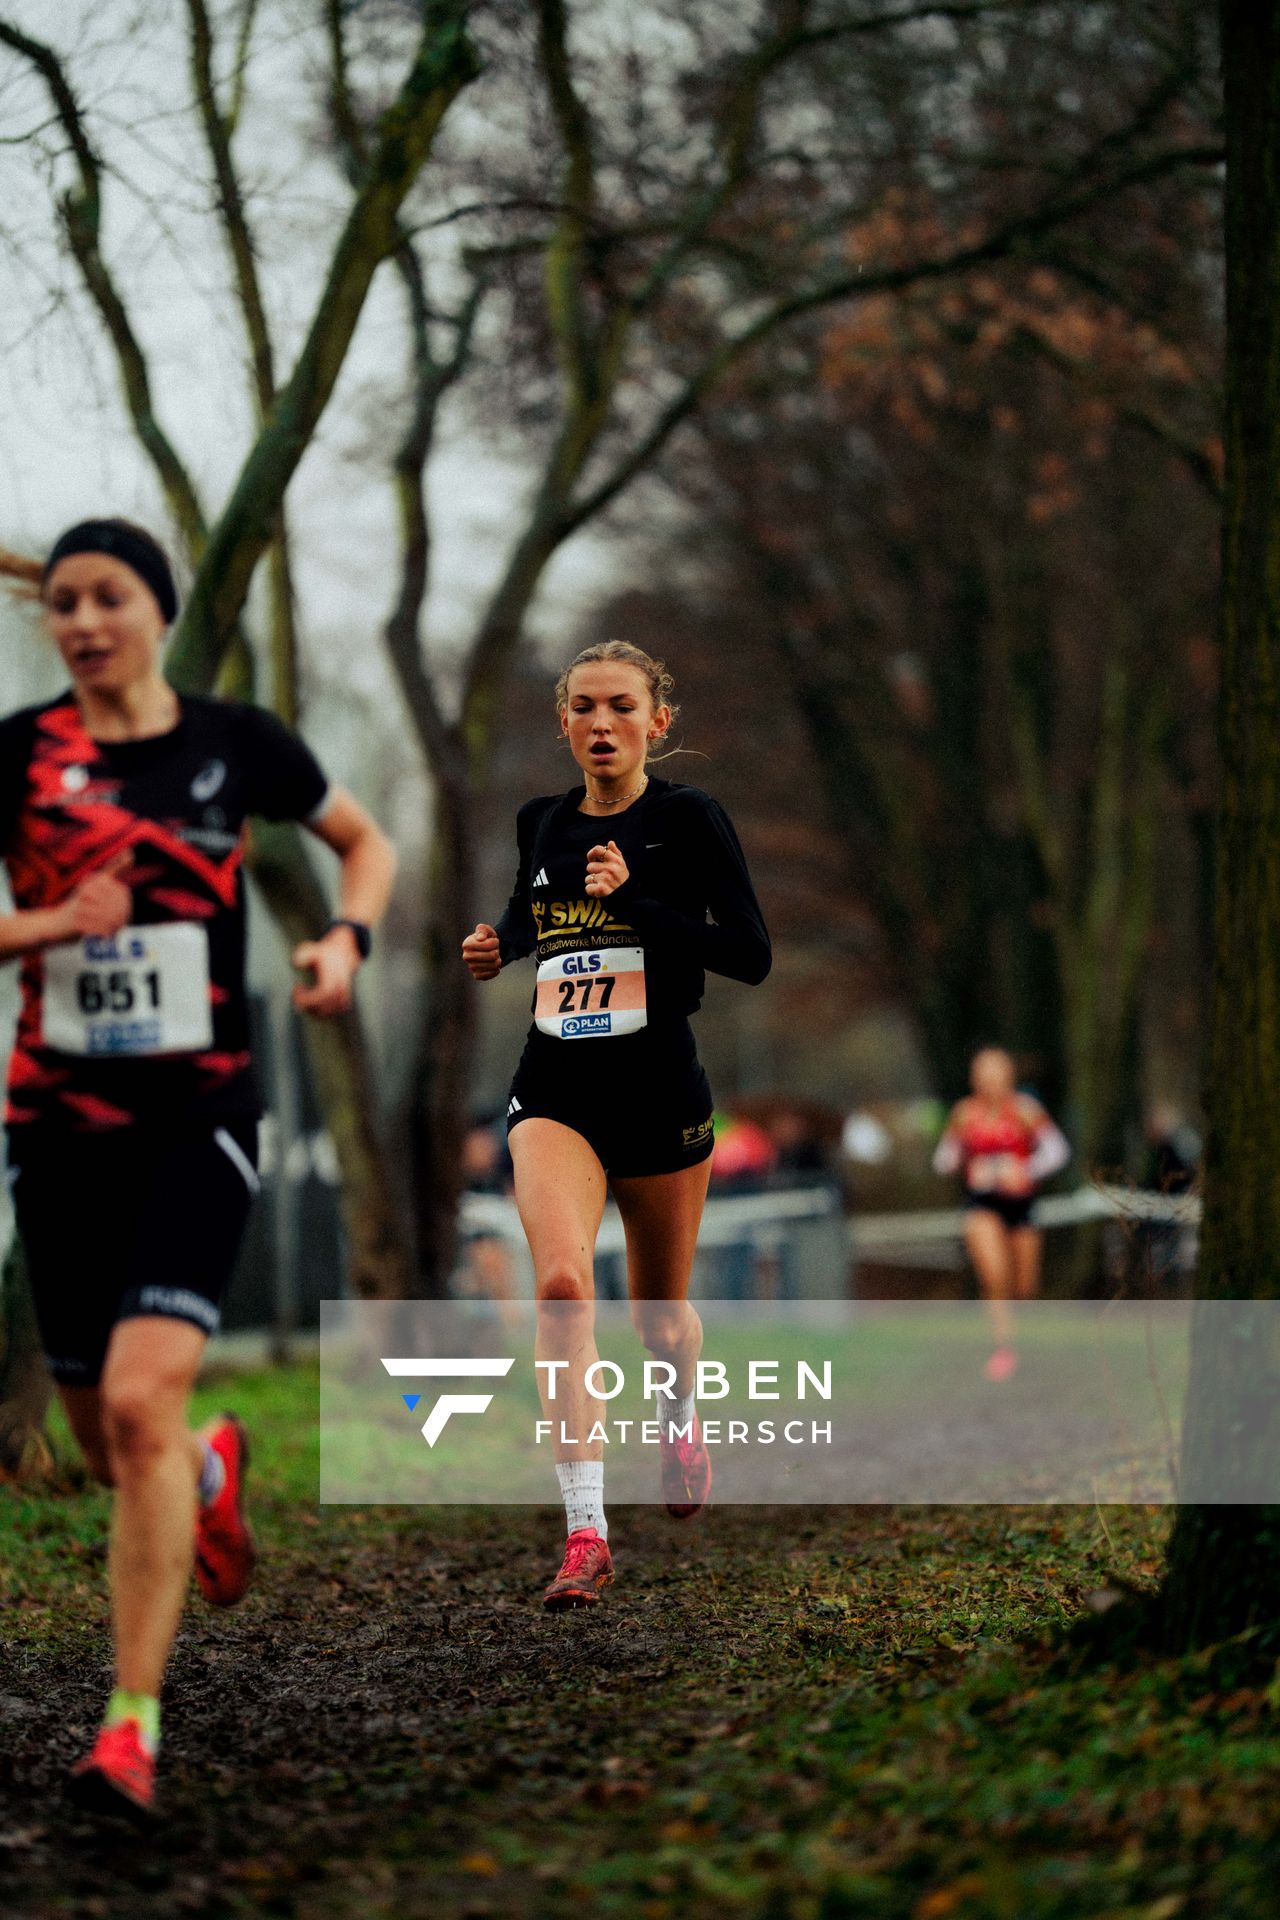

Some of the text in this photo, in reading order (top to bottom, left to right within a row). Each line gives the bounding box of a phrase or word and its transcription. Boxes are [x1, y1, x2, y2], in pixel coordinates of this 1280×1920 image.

[591, 935, 640, 946] München
[78, 970, 160, 1014] 651
[559, 976, 616, 1013] 277
[581, 1017, 609, 1028] PLAN
